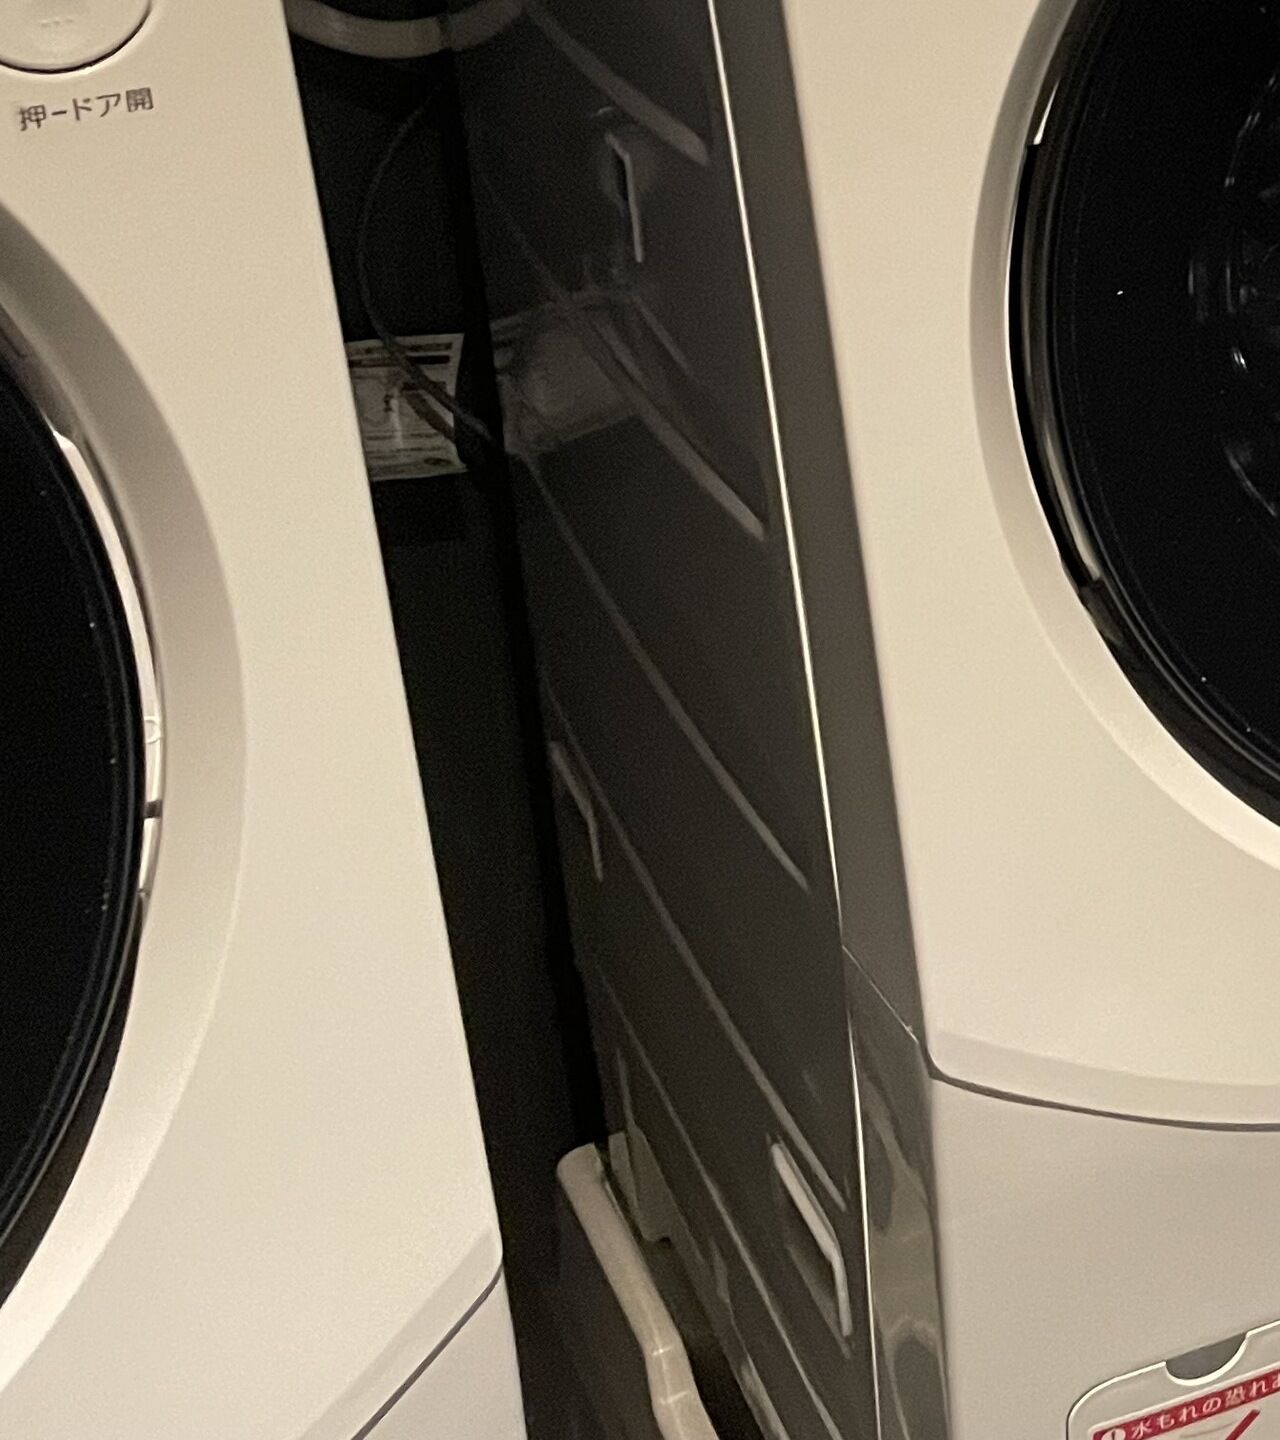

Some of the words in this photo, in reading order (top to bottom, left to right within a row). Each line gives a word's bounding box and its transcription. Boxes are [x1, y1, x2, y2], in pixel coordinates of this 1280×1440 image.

[18, 87, 155, 131] 押ードア開
